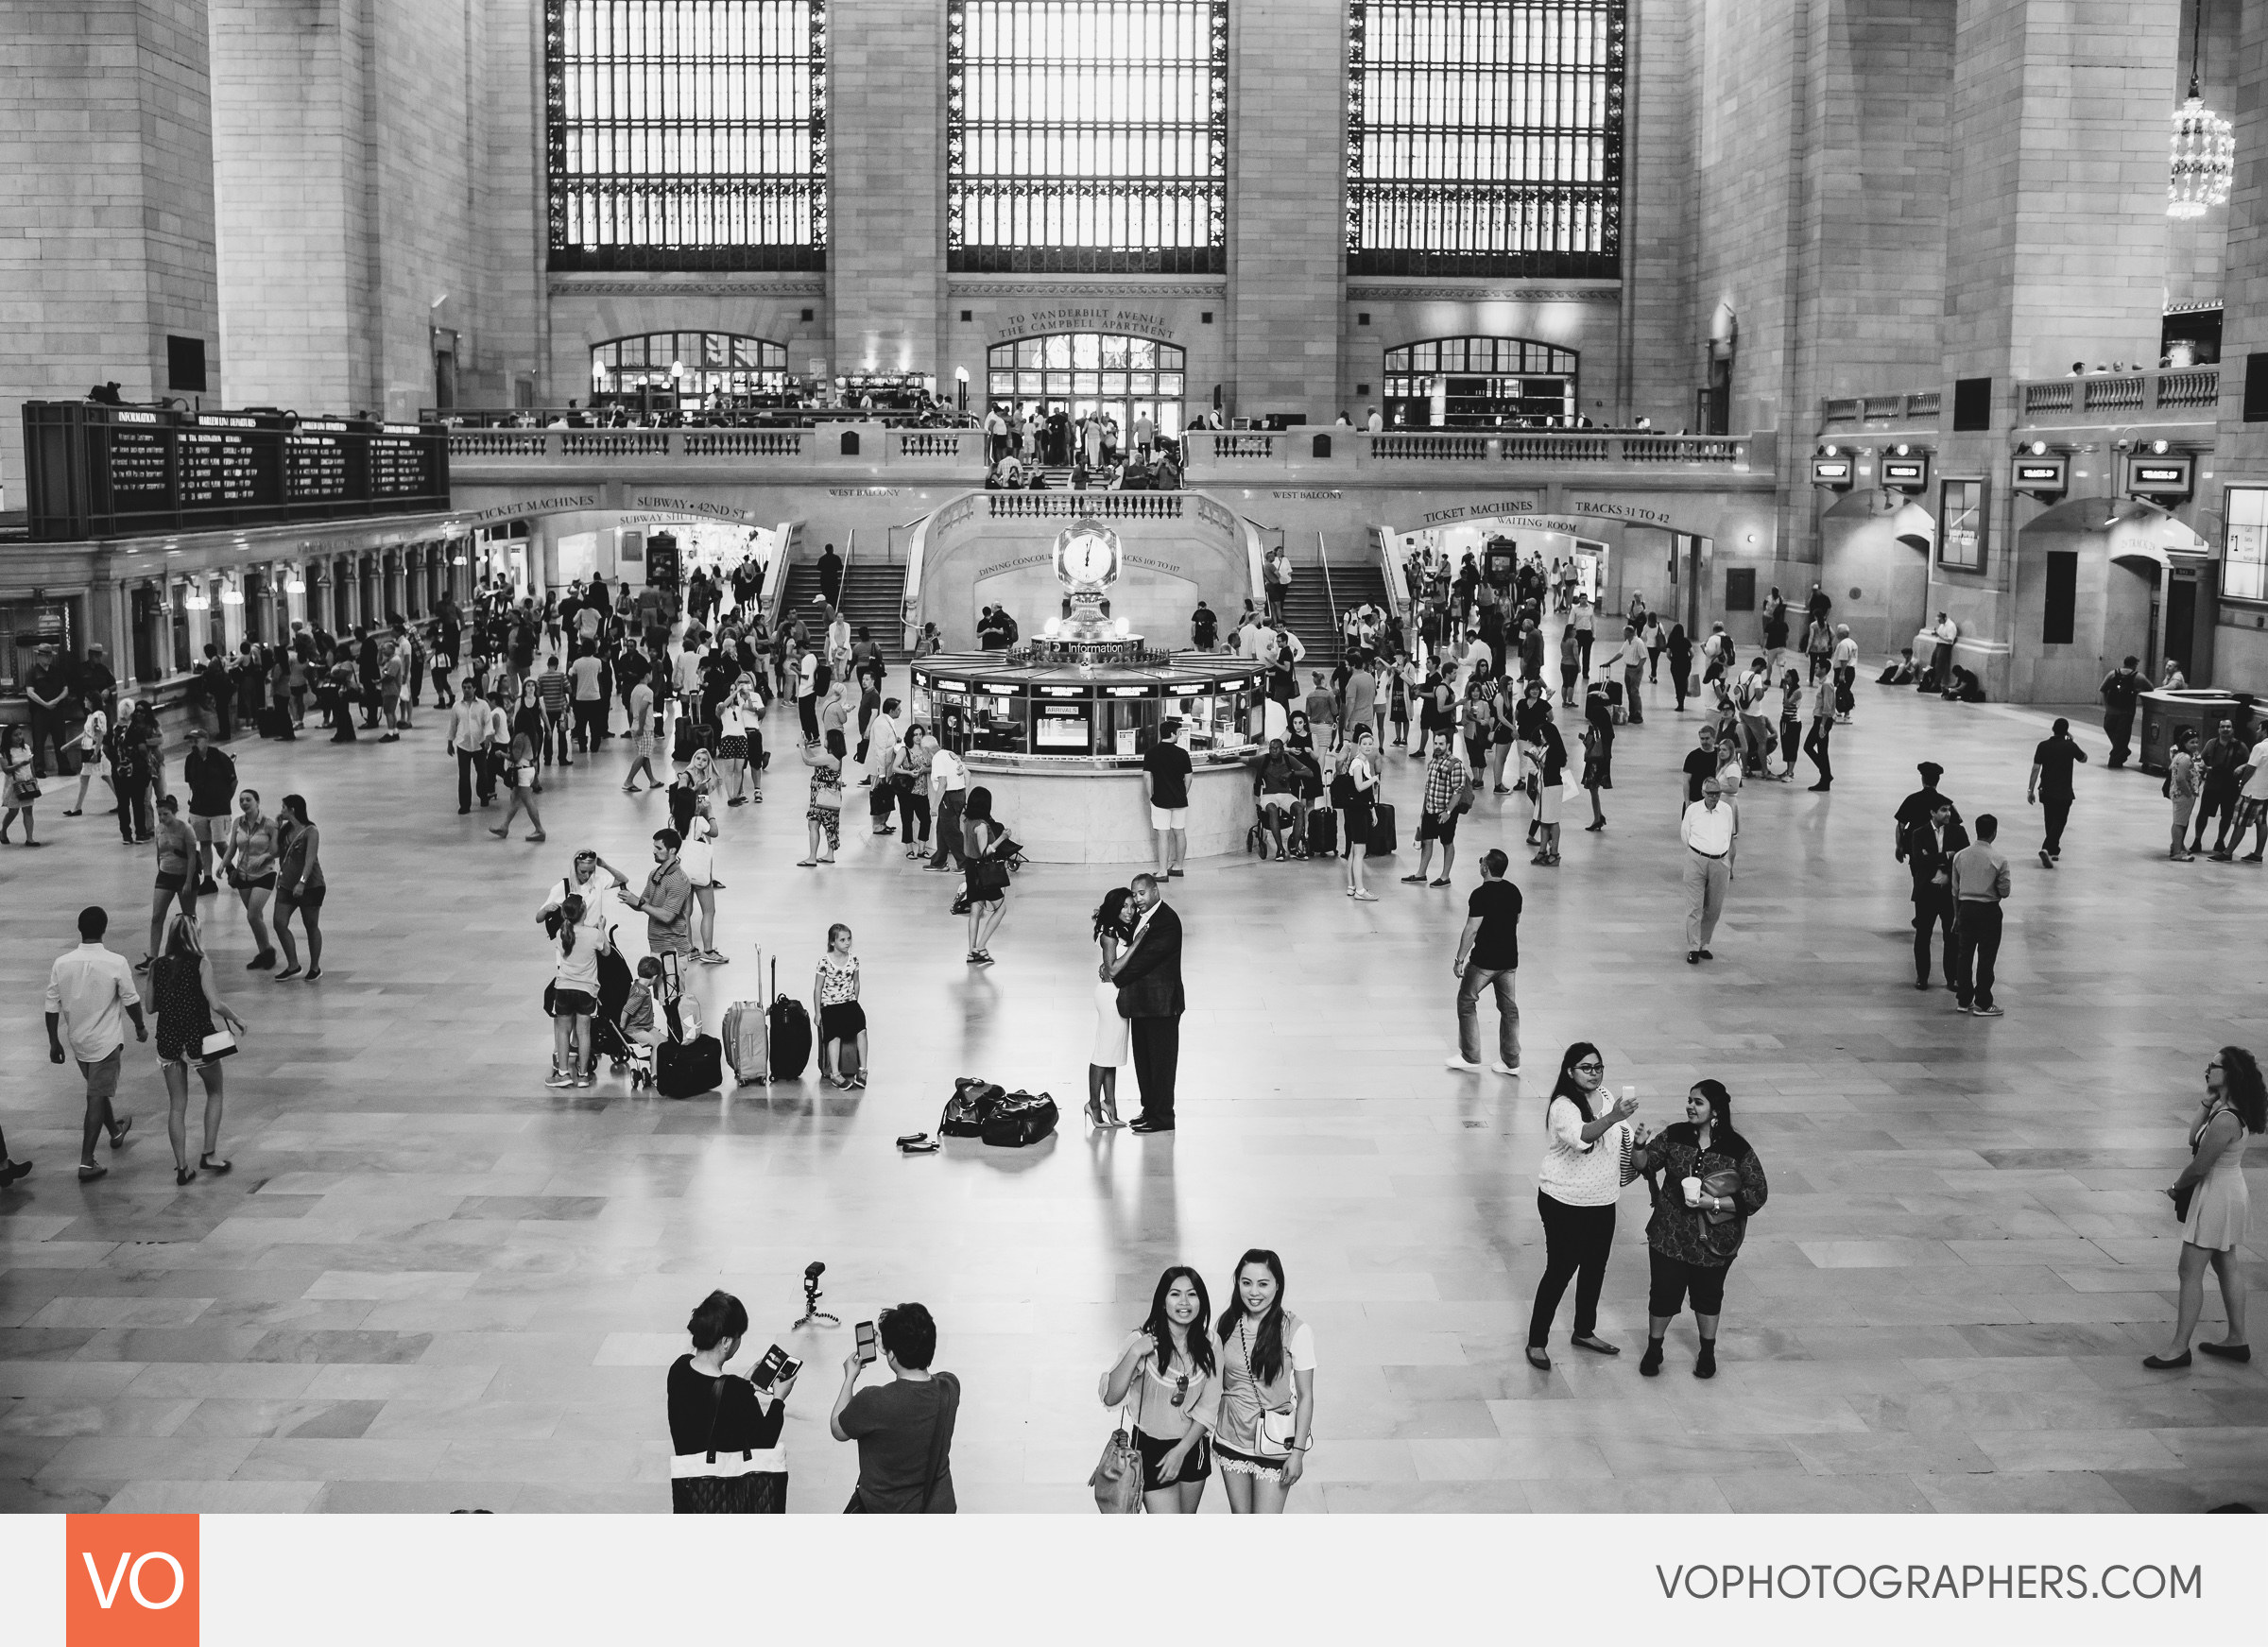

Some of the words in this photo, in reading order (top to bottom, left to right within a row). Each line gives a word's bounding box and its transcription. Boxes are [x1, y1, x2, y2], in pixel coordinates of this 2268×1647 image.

[1007, 314, 1025, 325] TO
[1031, 309, 1109, 320] VANDERBILT
[1116, 310, 1165, 326] AVENUE
[998, 325, 1025, 338] THE
[1031, 318, 1094, 332] CAMPBELL
[1101, 319, 1175, 338] APARTMENT
[856, 489, 901, 497] BALCONY
[1300, 491, 1343, 500] BALCONY
[476, 502, 523, 521] TICKET
[526, 495, 594, 512] MACHINES
[637, 496, 688, 509] SUBWAY
[697, 502, 730, 516] 42ND
[732, 508, 747, 520] ST
[1423, 506, 1466, 523] TICKET
[1470, 501, 1533, 516] MACHINES
[1575, 501, 1623, 515] TRACKS
[1624, 506, 1636, 517] 31
[1639, 508, 1656, 521] TO
[1658, 513, 1670, 523] 42
[619, 513, 663, 525] SUBWAY
[1497, 516, 1543, 527] WAITING
[1547, 521, 1577, 533] ROOM
[978, 560, 1011, 576] DINING
[1012, 553, 1053, 566] CONCOUR
[1122, 554, 1143, 563] ACKS
[1143, 558, 1156, 566] 100
[1158, 560, 1169, 570] TO
[1068, 643, 1124, 653] Information
